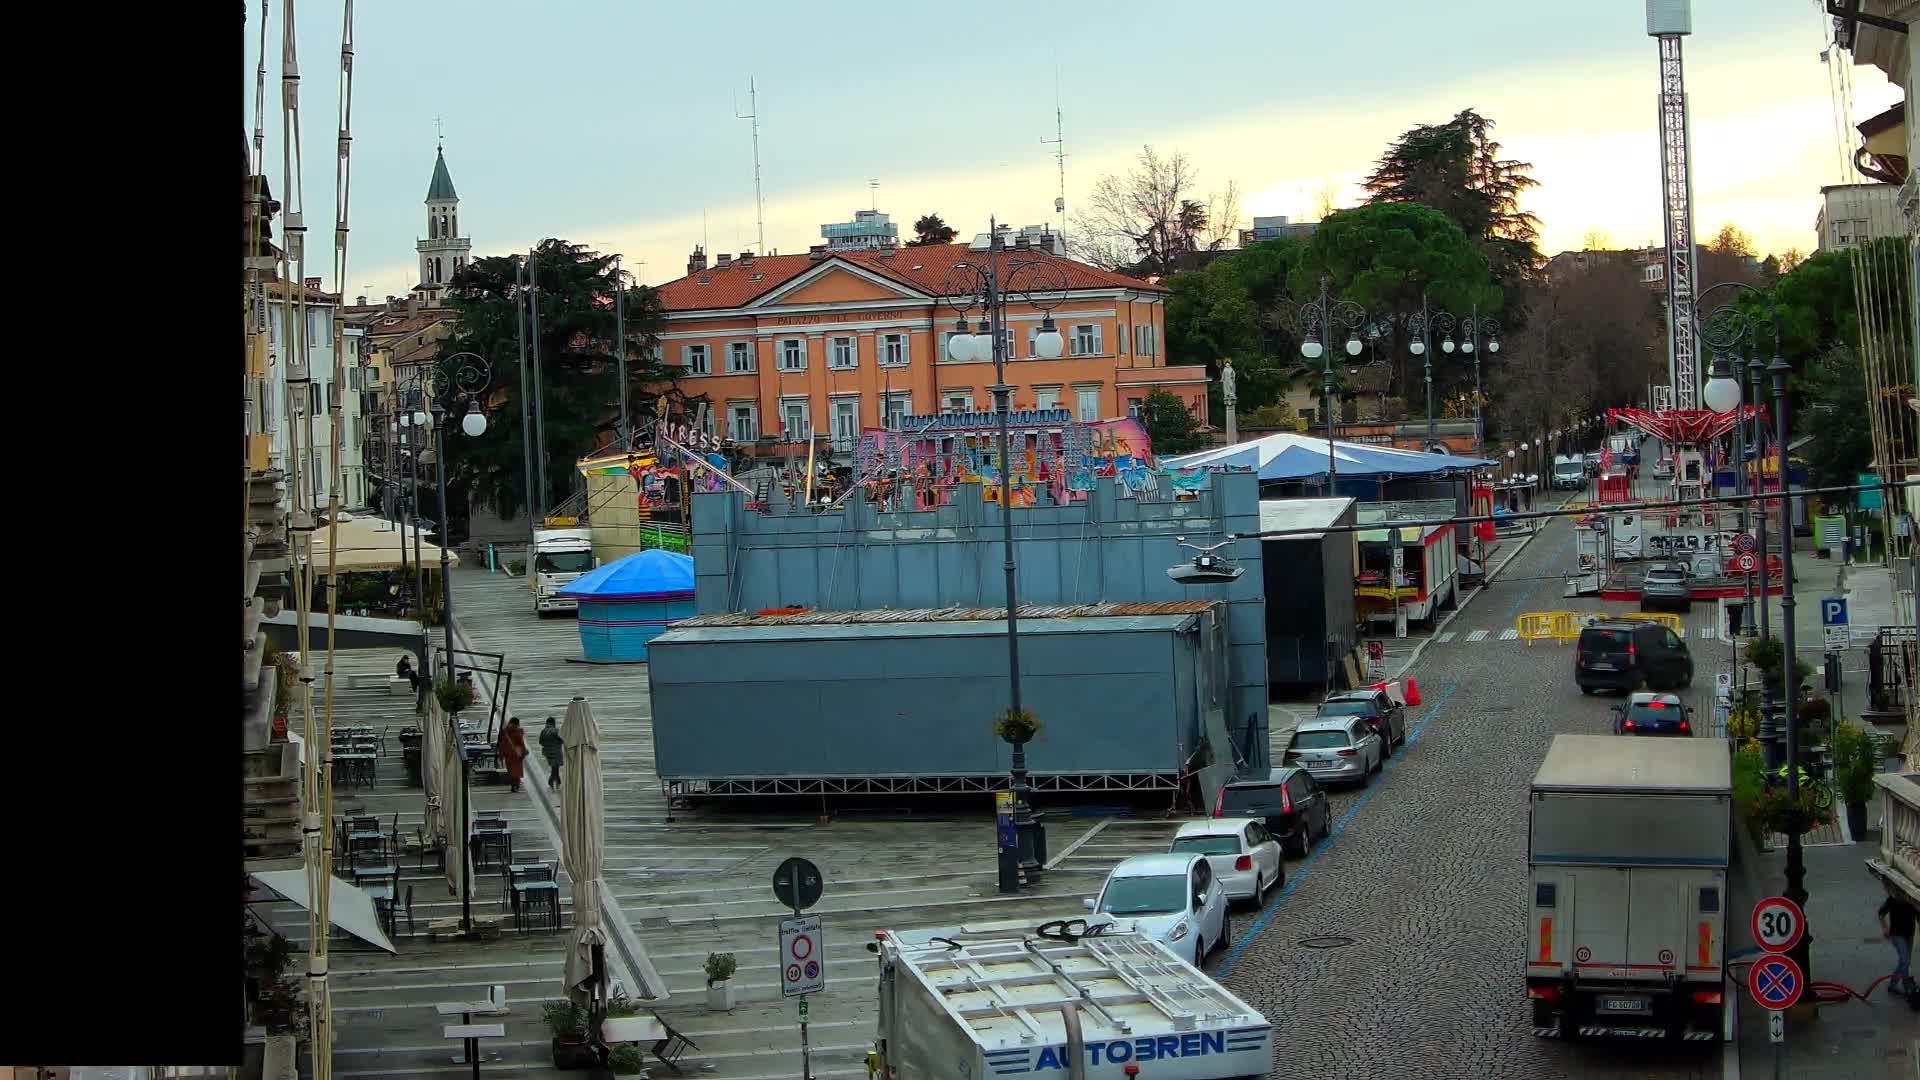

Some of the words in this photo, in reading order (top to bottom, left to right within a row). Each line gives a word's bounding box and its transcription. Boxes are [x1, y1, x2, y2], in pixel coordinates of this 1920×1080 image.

[1741, 556, 1753, 568] 20
[1827, 602, 1842, 622] P
[1762, 911, 1792, 938] 30
